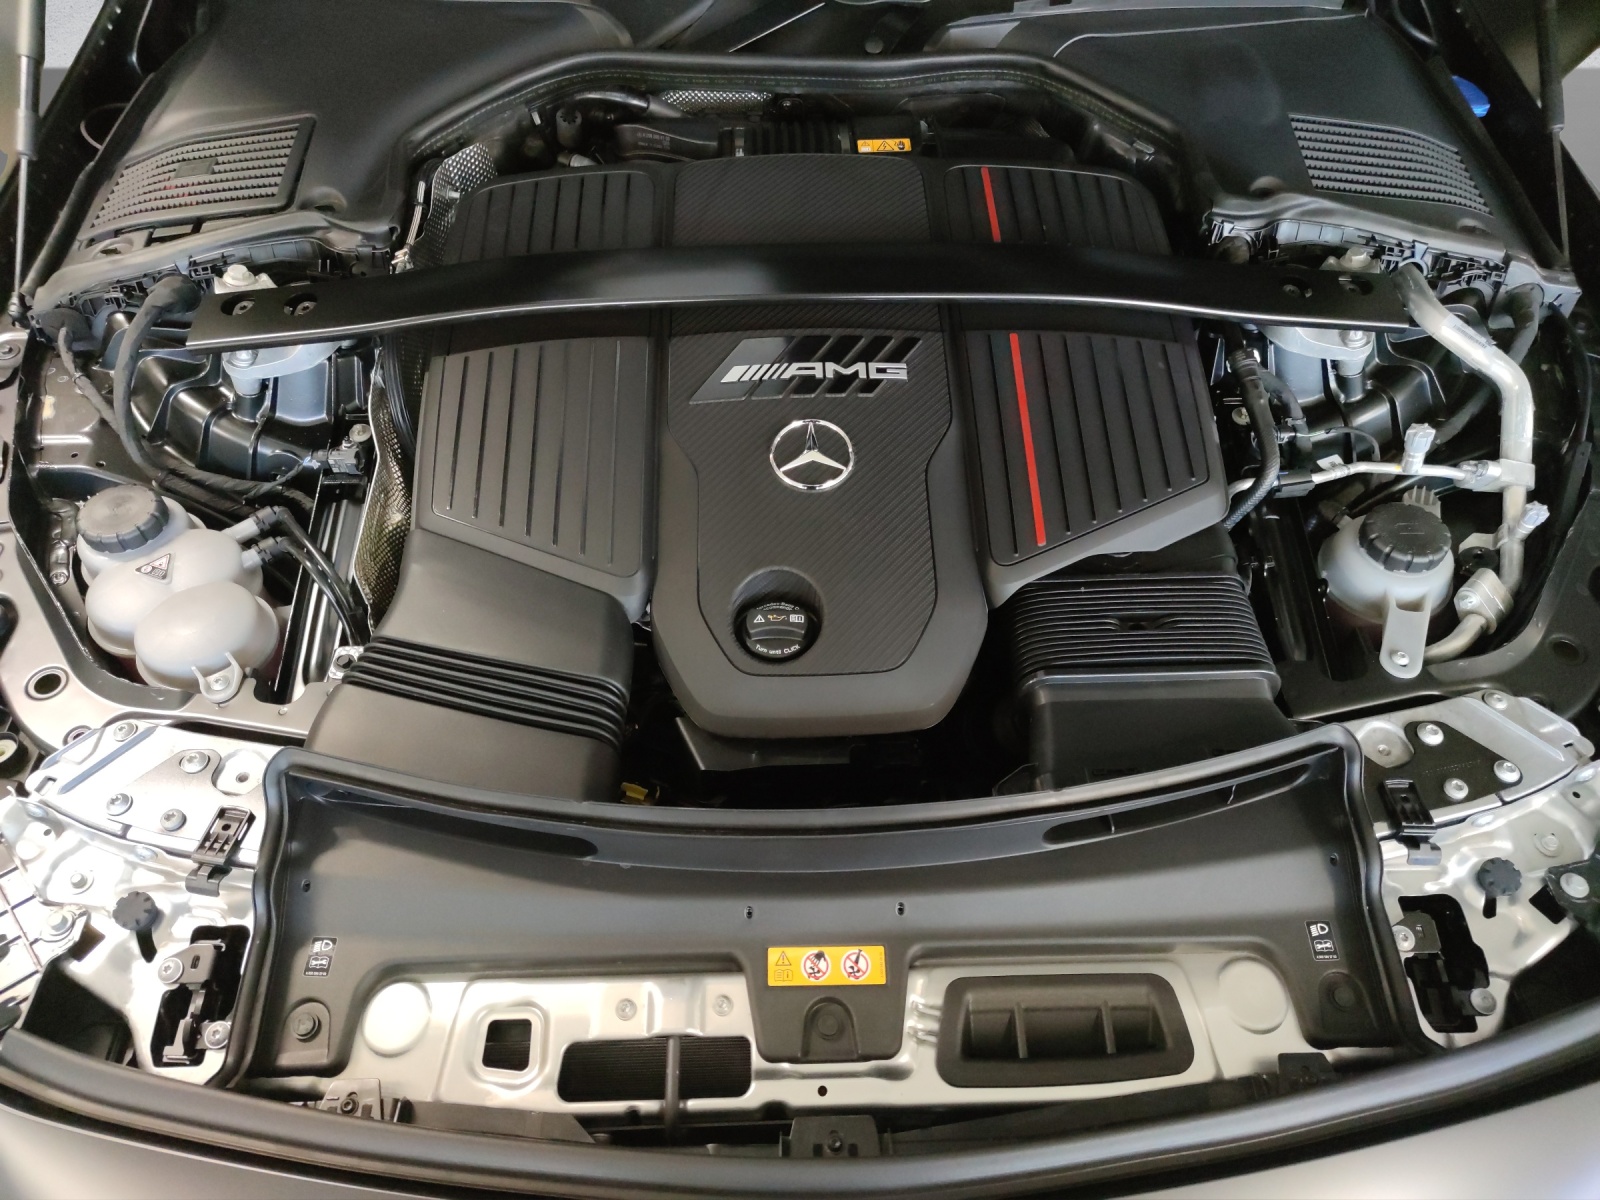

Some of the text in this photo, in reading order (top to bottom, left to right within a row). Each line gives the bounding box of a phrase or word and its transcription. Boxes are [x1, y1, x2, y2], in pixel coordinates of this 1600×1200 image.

[780, 361, 908, 382] AMG
[756, 644, 767, 653] Turn
[784, 644, 800, 653] CLICK
